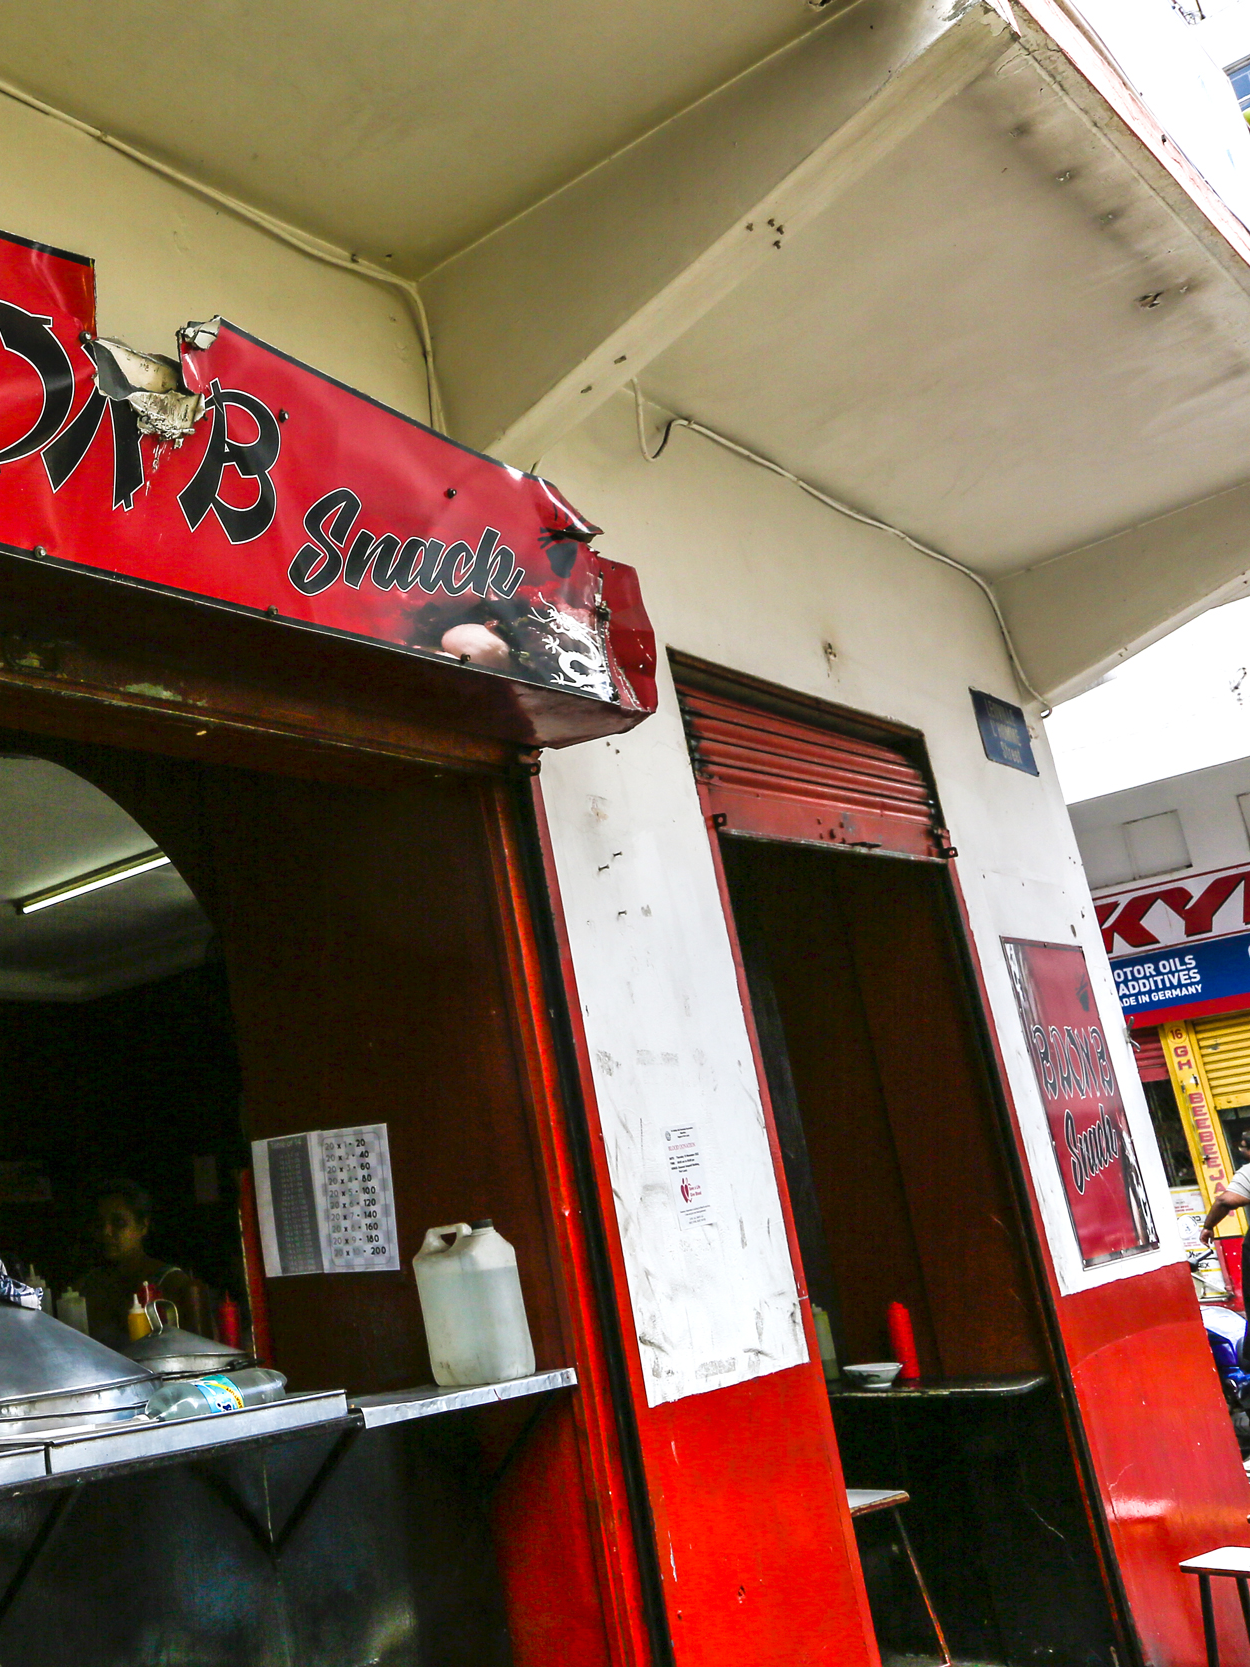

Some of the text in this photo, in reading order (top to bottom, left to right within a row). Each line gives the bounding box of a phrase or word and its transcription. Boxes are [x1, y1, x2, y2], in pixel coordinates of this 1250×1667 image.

[287, 487, 525, 599] Snack
[1158, 954, 1196, 973] OILS
[1119, 969, 1201, 996] ADDITIVES
[1138, 994, 1150, 1004] IN
[1151, 984, 1203, 1001] GERMANY
[1170, 1028, 1183, 1041] 16
[355, 1139, 365, 1147] 20
[1064, 1103, 1119, 1195] Snack
[359, 1150, 369, 1158] 40
[361, 1162, 370, 1170] 60
[362, 1174, 372, 1182] 80
[362, 1186, 376, 1195] 100
[364, 1198, 376, 1206] 120
[364, 1210, 377, 1218] 140
[365, 1222, 378, 1231] 160
[367, 1234, 379, 1243] 180
[371, 1246, 386, 1255] 200
